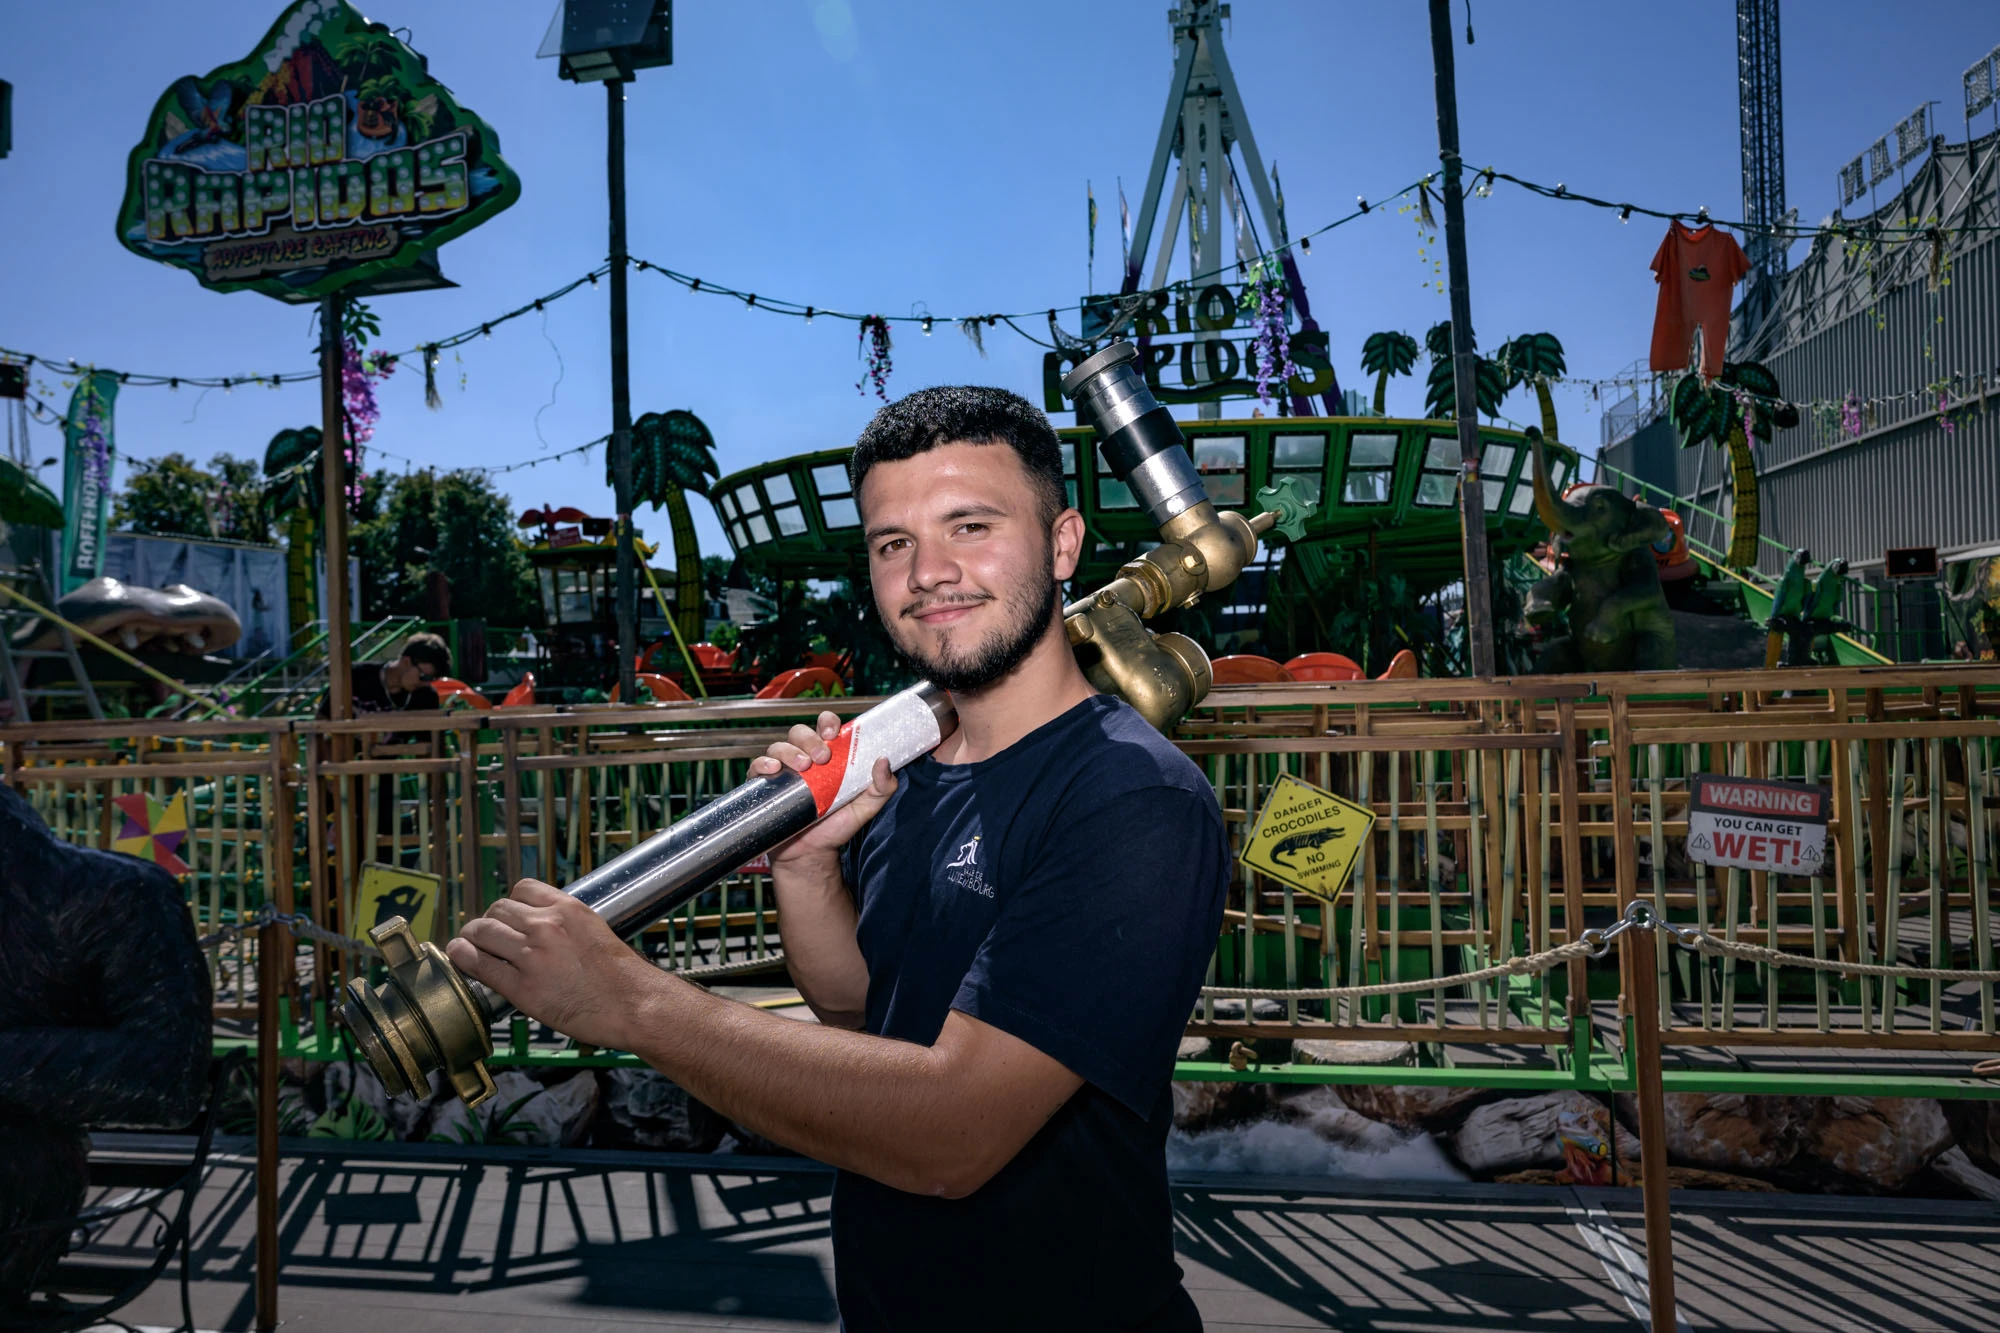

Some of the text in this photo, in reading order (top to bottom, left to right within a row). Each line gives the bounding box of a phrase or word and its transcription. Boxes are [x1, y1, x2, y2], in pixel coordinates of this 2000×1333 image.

[247, 95, 346, 171] RIO
[143, 134, 469, 242] RAPIDOS
[212, 227, 391, 271] ADVENTURE RAFTING
[1273, 798, 1322, 820] DANGER
[1709, 785, 1812, 813] WARNING
[1262, 805, 1341, 839] CROCODILES
[1714, 817, 1803, 836] YOU CAN GET
[1306, 852, 1325, 865] NO
[1712, 832, 1802, 866] WET!
[1297, 860, 1342, 880] SWIMMING
